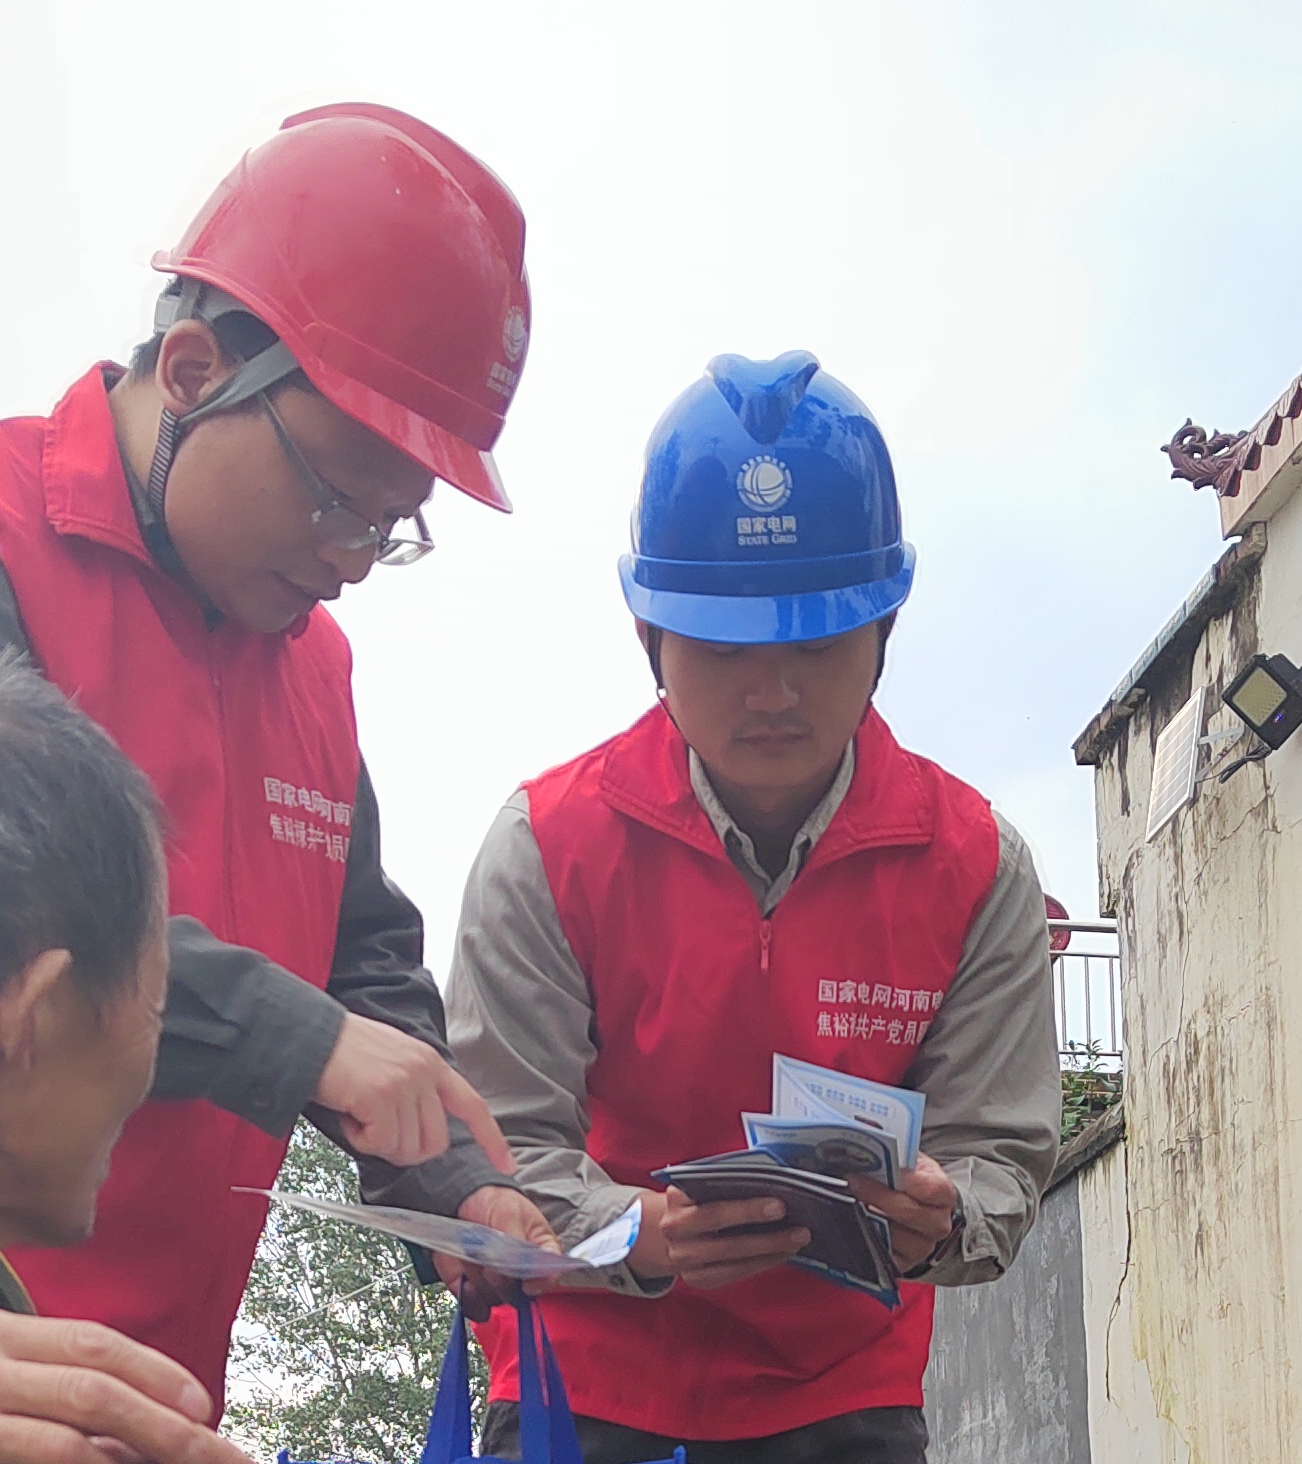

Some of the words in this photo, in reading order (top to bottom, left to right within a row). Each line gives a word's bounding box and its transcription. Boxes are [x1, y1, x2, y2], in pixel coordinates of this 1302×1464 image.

[737, 515, 797, 535] 国家电网
[737, 534, 770, 546] STATE
[771, 533, 797, 544] GRID
